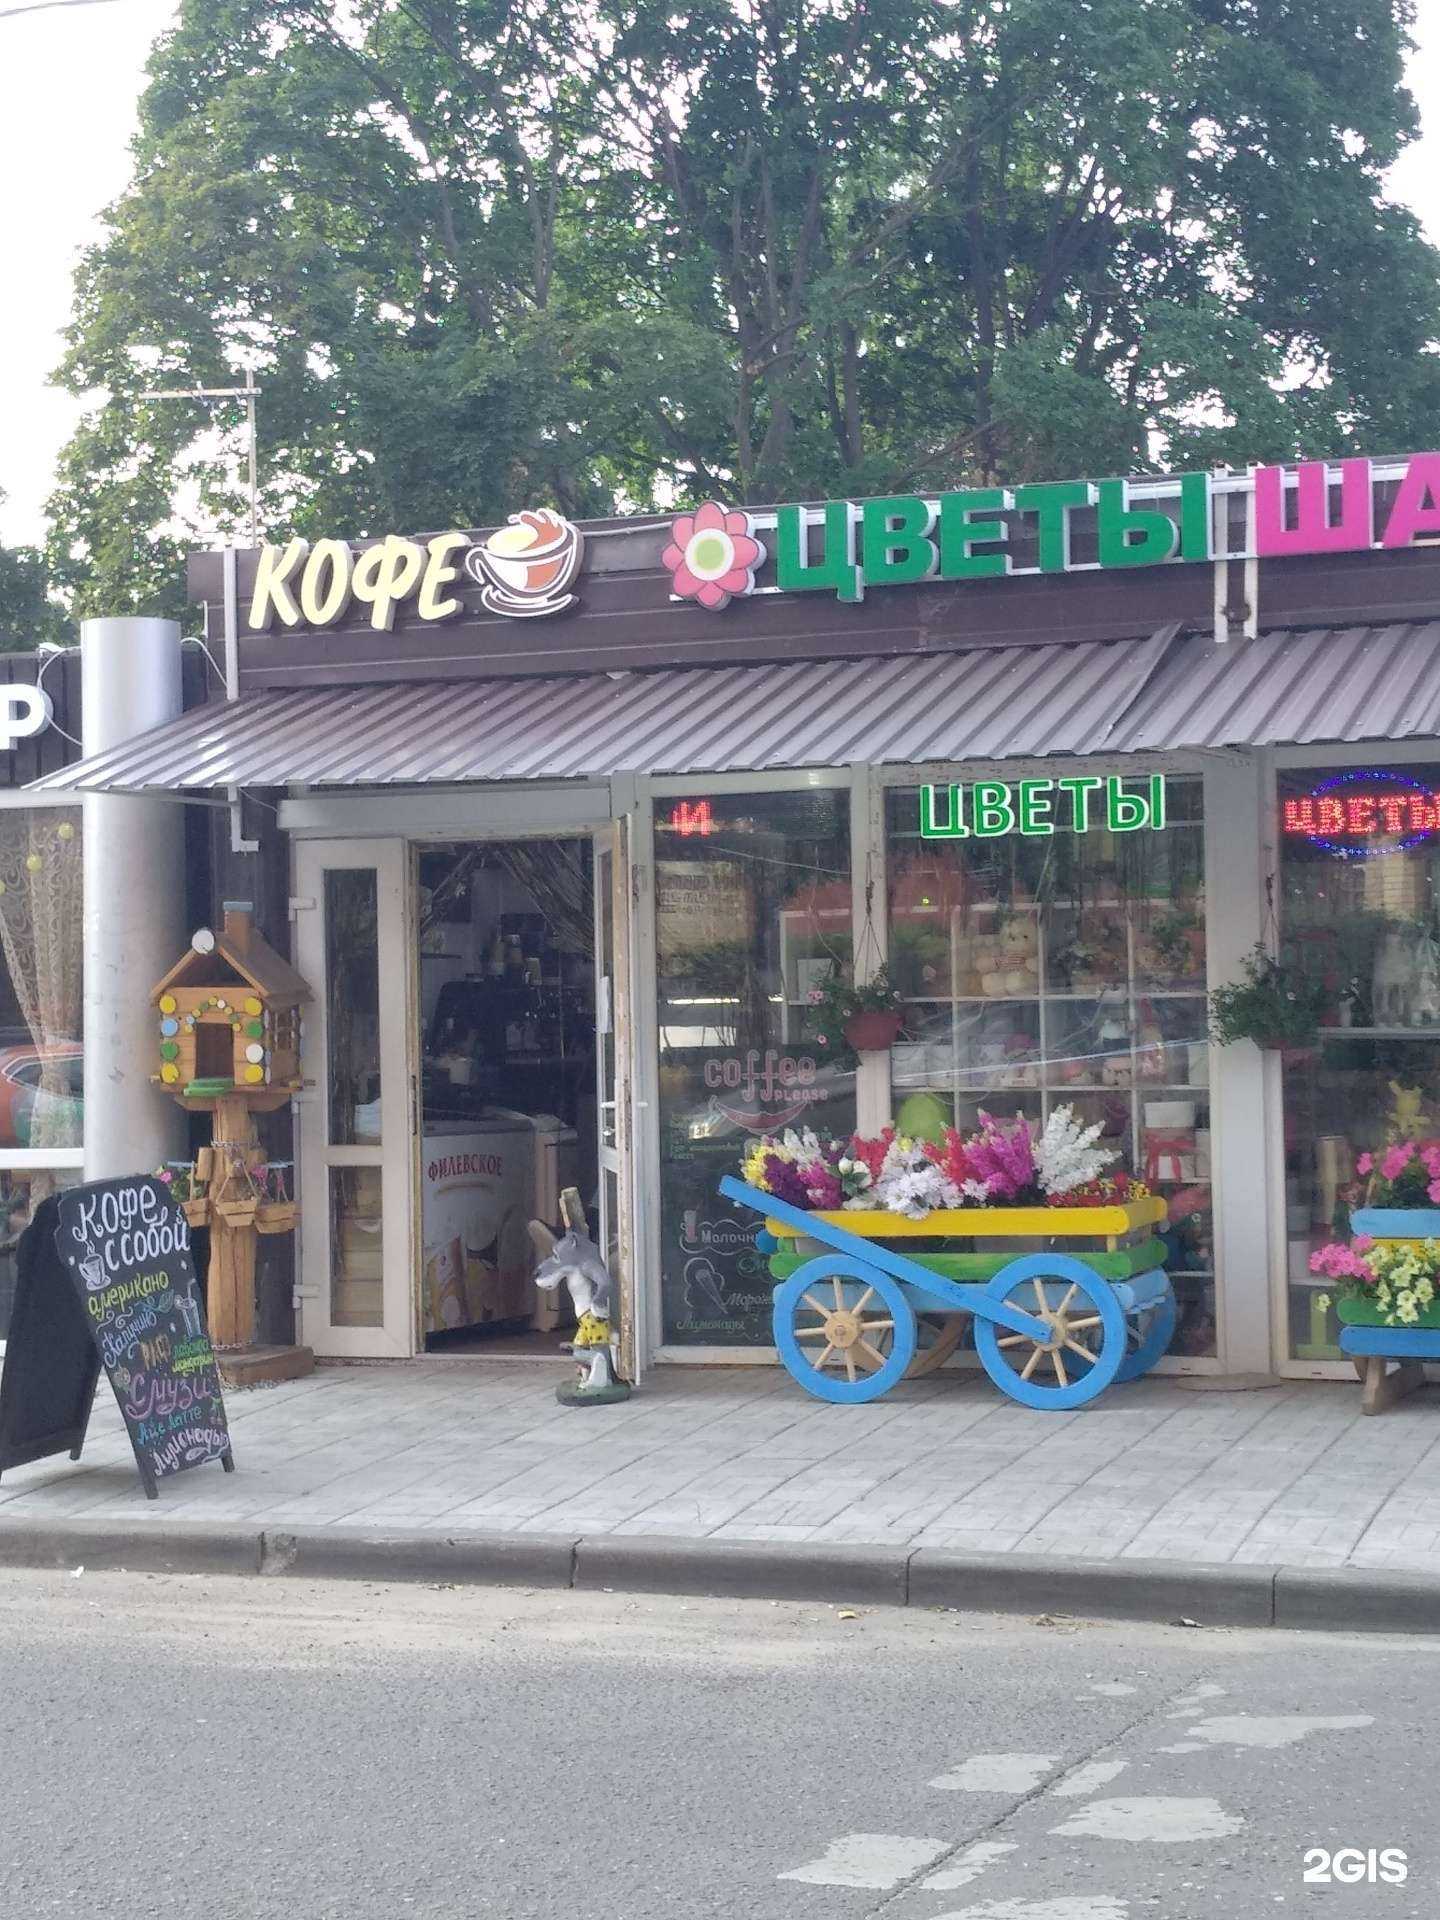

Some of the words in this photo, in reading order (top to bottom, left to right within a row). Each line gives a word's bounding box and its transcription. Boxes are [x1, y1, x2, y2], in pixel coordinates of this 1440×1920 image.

[777, 471, 1214, 602] ЦВЕТЫ
[1255, 451, 1440, 557] ША
[249, 533, 472, 632] КОФЕ
[920, 774, 1166, 838] ЦВЕТЫ
[704, 1049, 816, 1102] coffee
[428, 1153, 503, 1181] ФИЛЕВСКОЕ
[72, 1185, 158, 1242] Кофе
[121, 1206, 190, 1266] собой
[89, 1271, 169, 1321] американо
